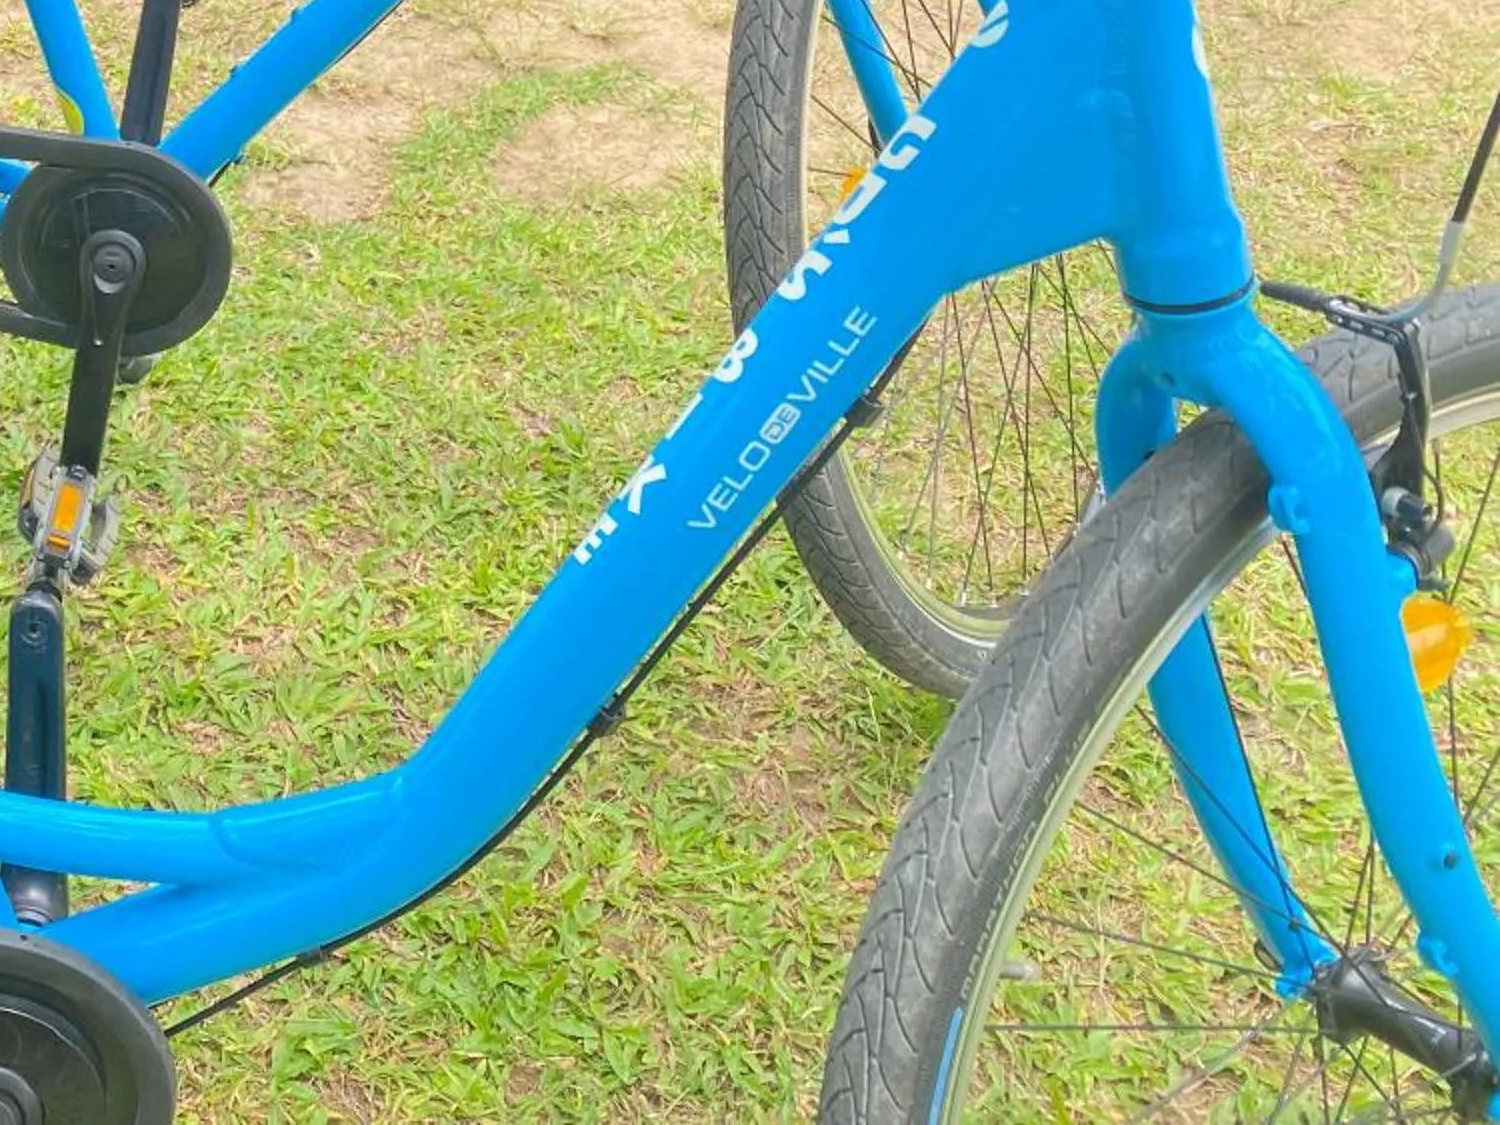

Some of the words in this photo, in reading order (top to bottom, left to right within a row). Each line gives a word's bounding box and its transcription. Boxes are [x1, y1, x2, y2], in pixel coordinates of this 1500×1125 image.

[687, 440, 771, 529] VELO
[760, 404, 802, 444] DE
[787, 306, 878, 403] VILLE
